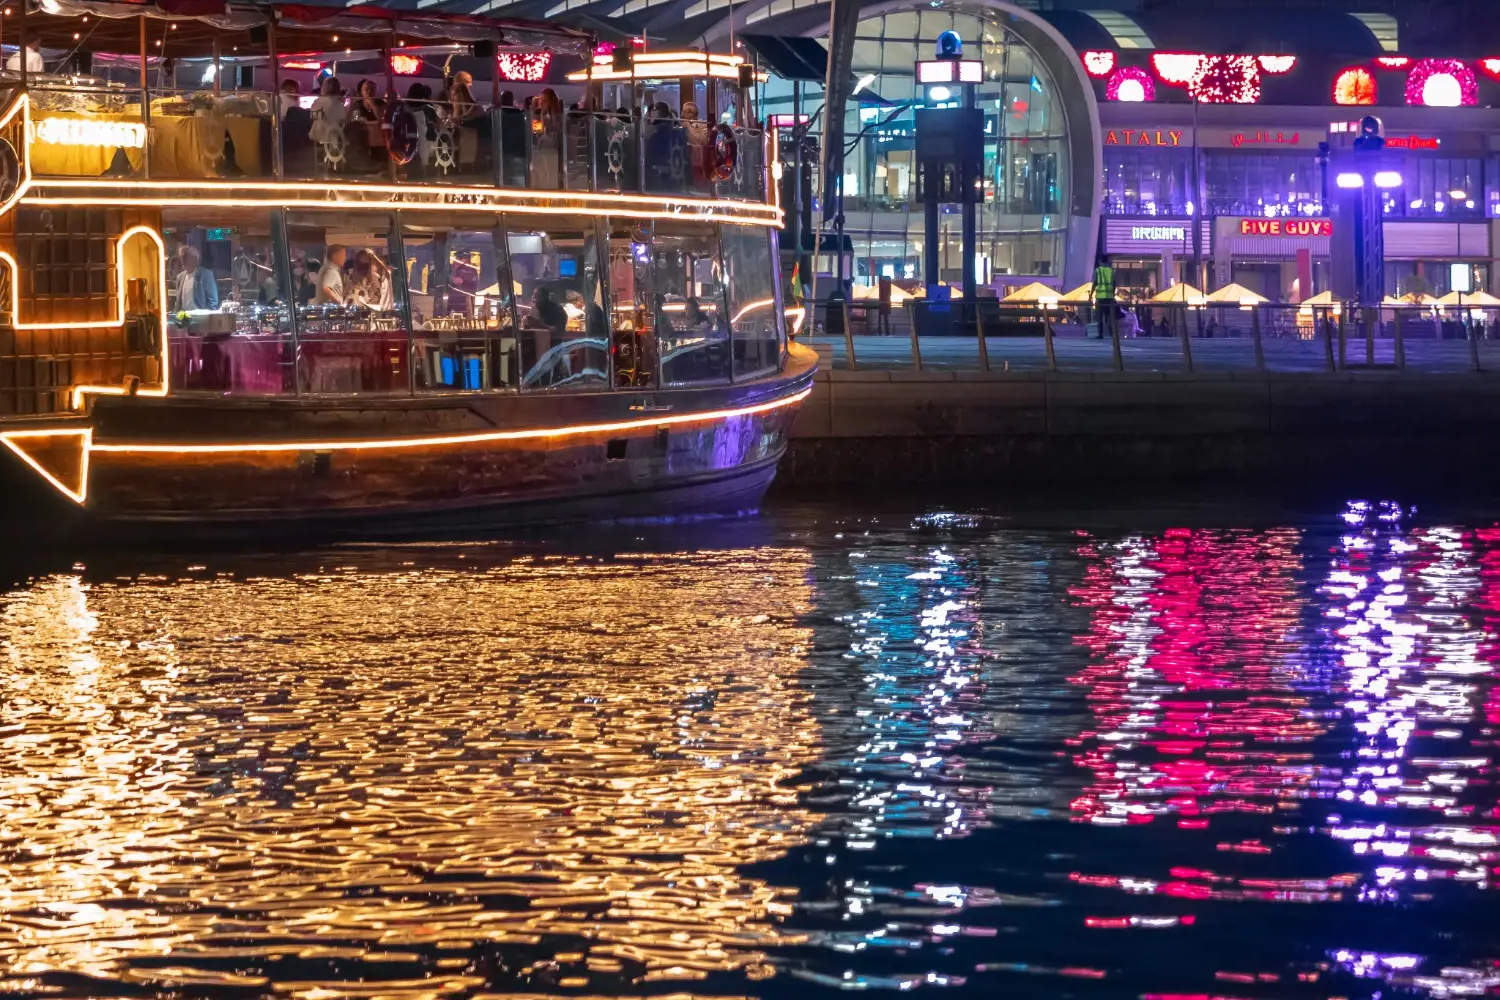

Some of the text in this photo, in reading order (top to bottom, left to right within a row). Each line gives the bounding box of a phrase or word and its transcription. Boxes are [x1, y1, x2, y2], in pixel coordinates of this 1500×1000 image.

[1105, 130, 1183, 146] ATALY
[1241, 220, 1332, 236] FIVE GUYS
